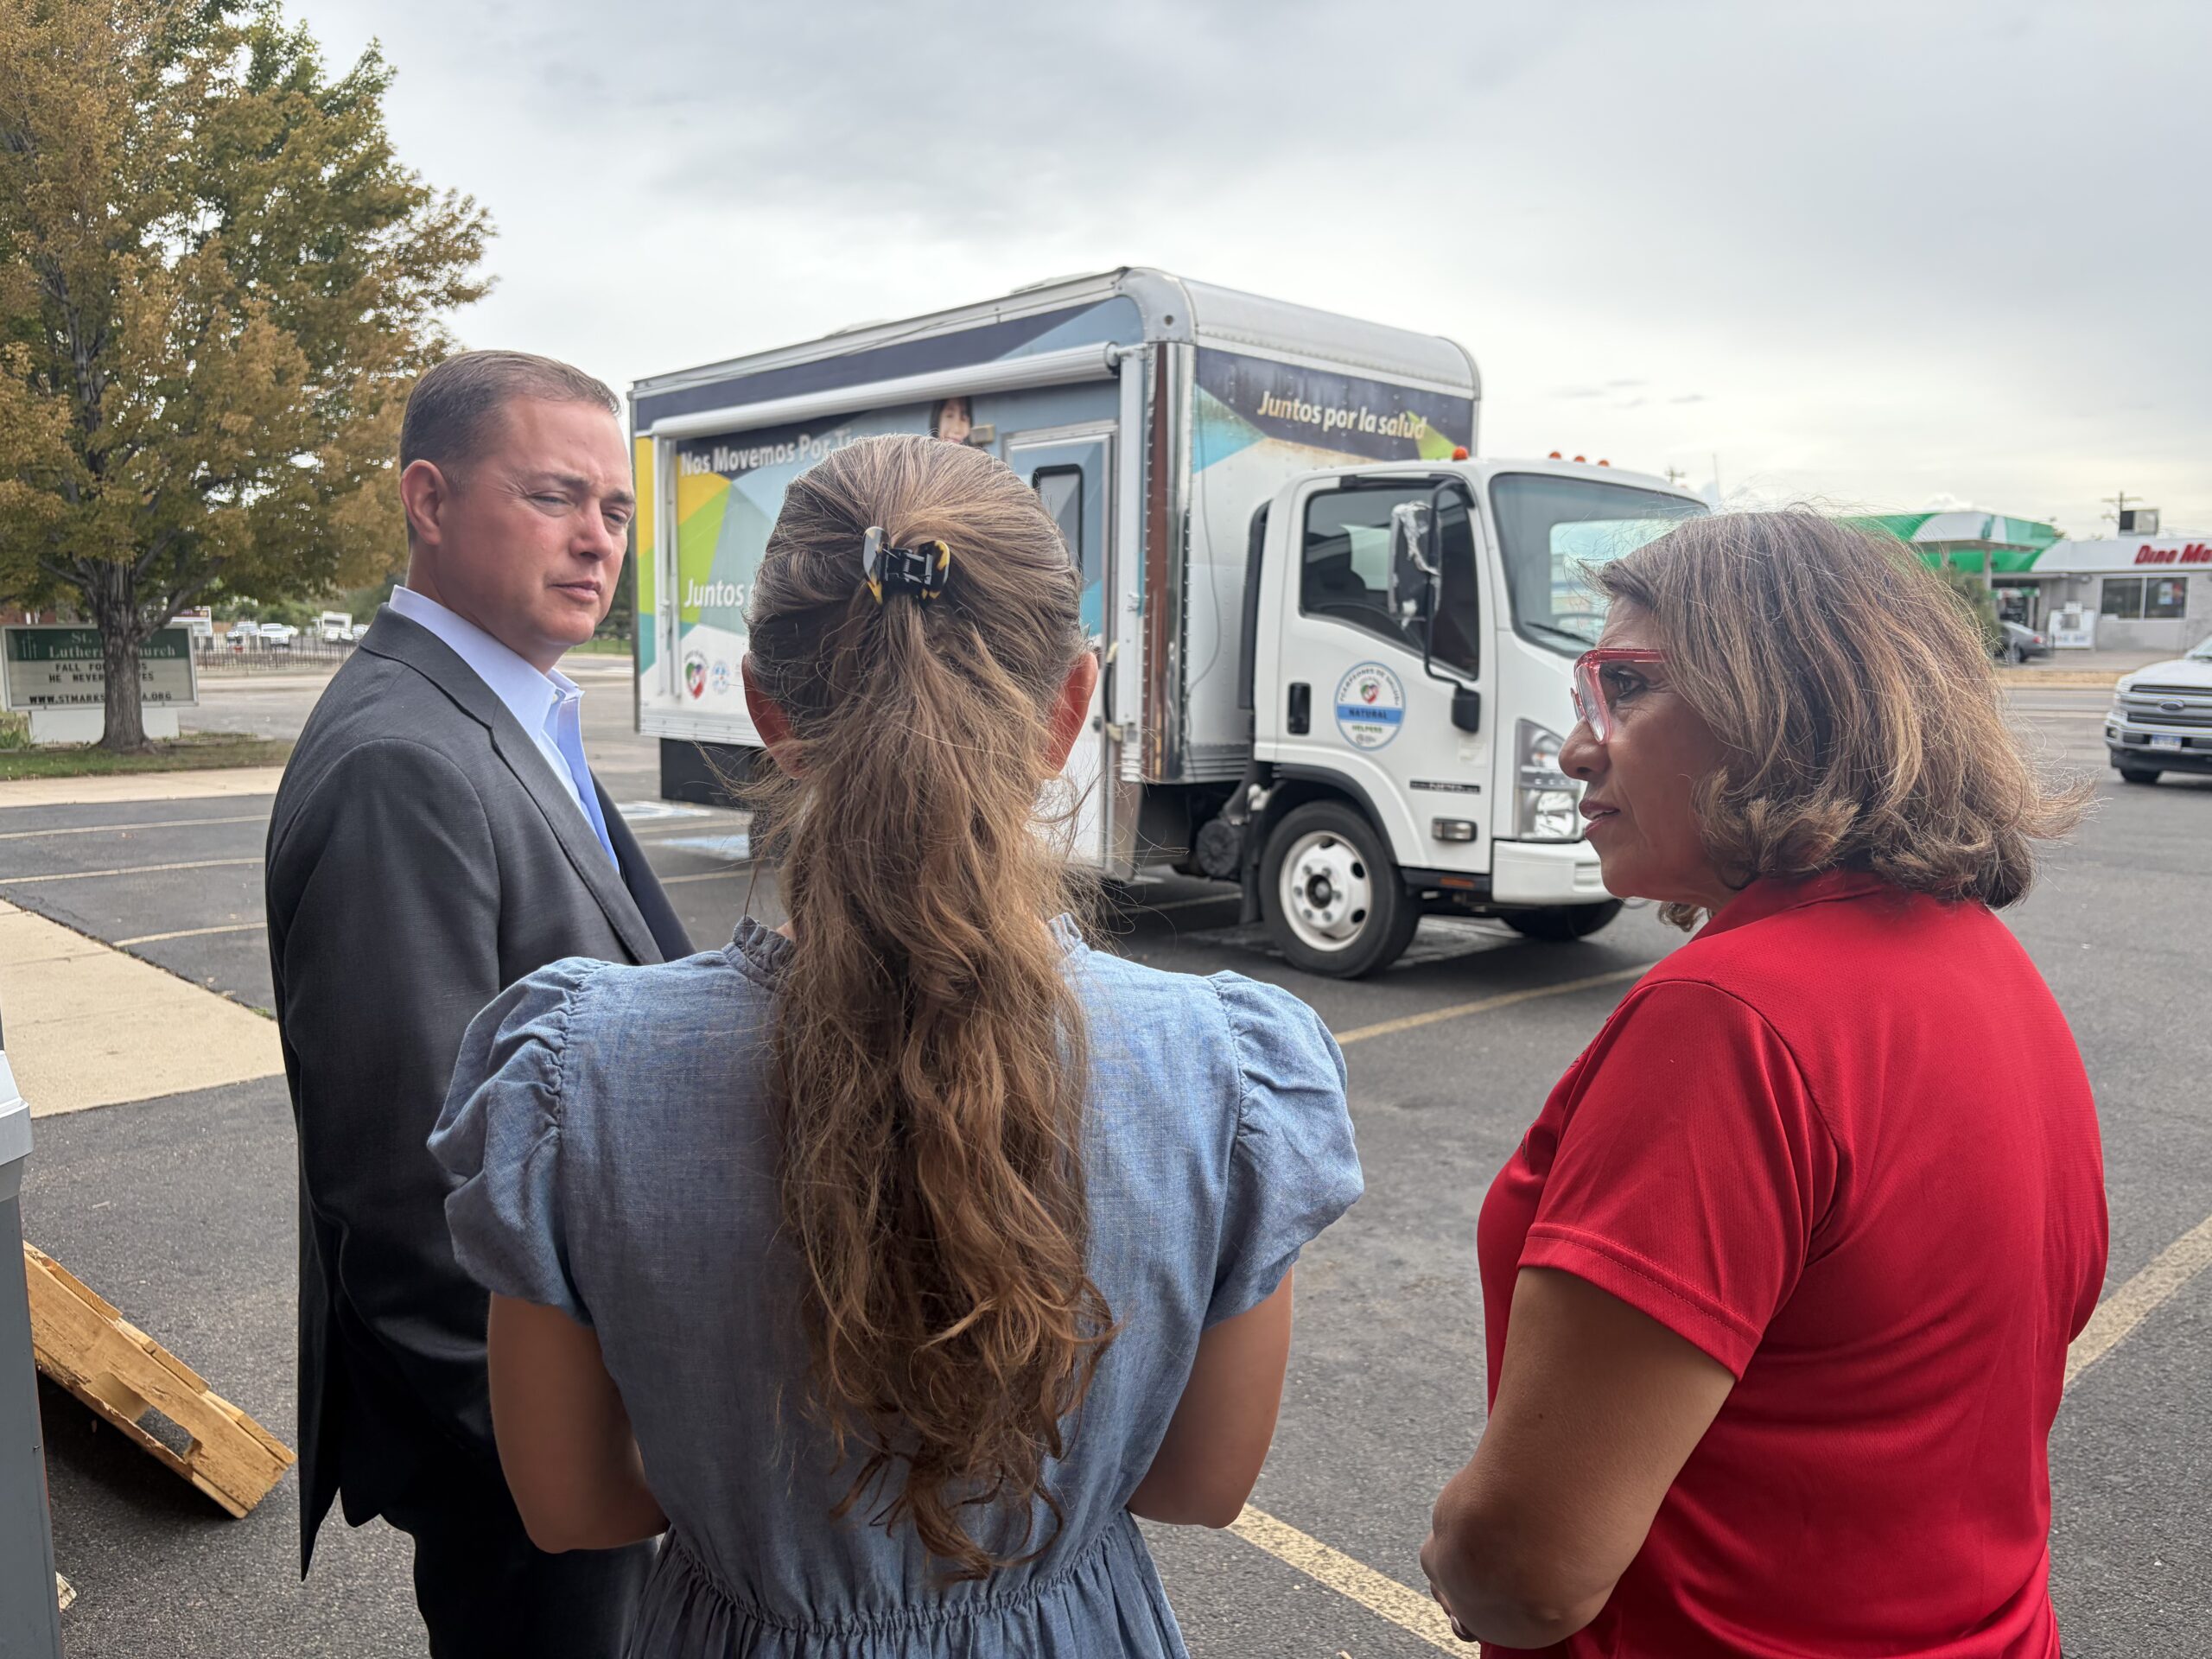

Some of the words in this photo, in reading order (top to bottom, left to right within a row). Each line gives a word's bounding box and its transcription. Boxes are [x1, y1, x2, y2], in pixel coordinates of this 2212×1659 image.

[1257, 391, 1323, 424] Juntos
[1322, 407, 1358, 432] por
[1357, 405, 1377, 433] la
[1378, 412, 1427, 440] salud
[681, 452, 710, 476] Nos
[713, 444, 795, 473] Movemos
[798, 435, 830, 461] Por
[683, 577, 745, 608] Juntos
[48, 673, 61, 683] HE
[55, 663, 80, 672] FALL
[89, 663, 105, 671] FO
[1349, 708, 1388, 720] NATURAL
